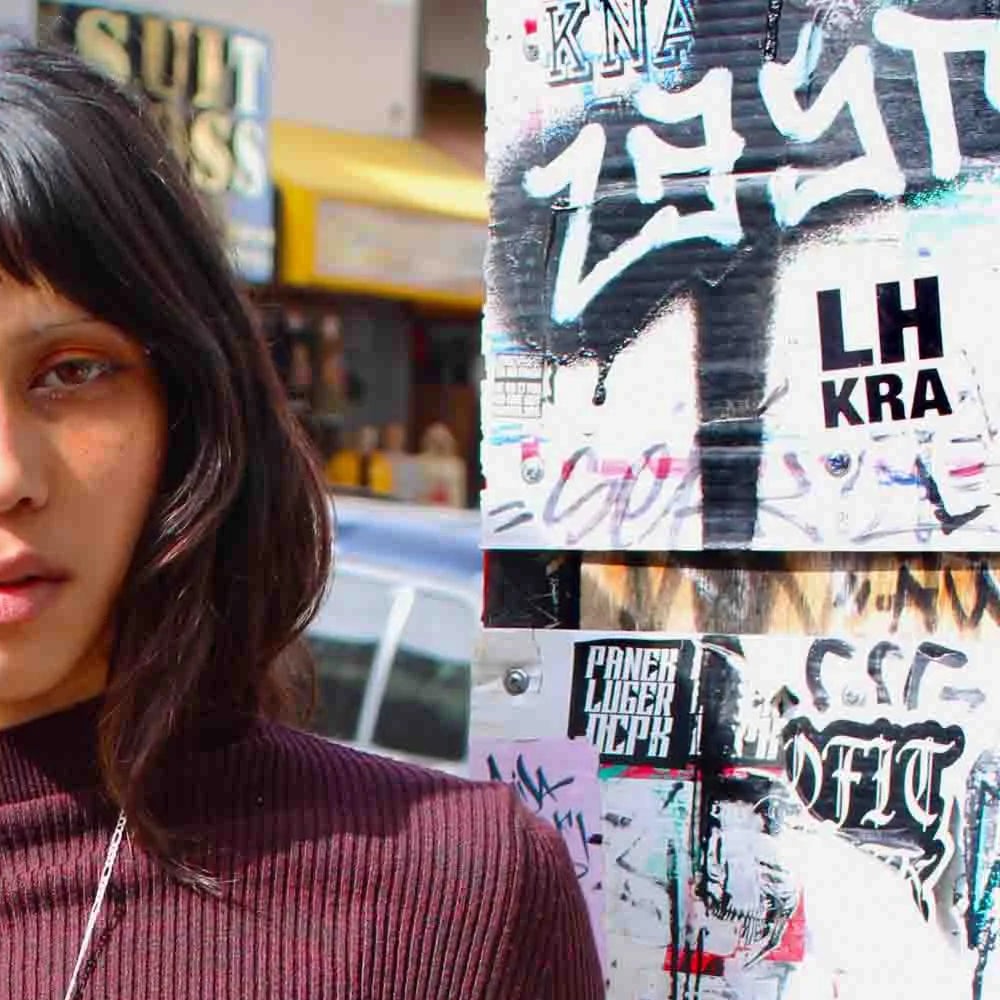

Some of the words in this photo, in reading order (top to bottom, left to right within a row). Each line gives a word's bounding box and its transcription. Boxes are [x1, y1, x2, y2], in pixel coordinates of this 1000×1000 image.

[816, 275, 944, 372] LH
[821, 368, 953, 429] KRA
[583, 678, 677, 718] LUGER
